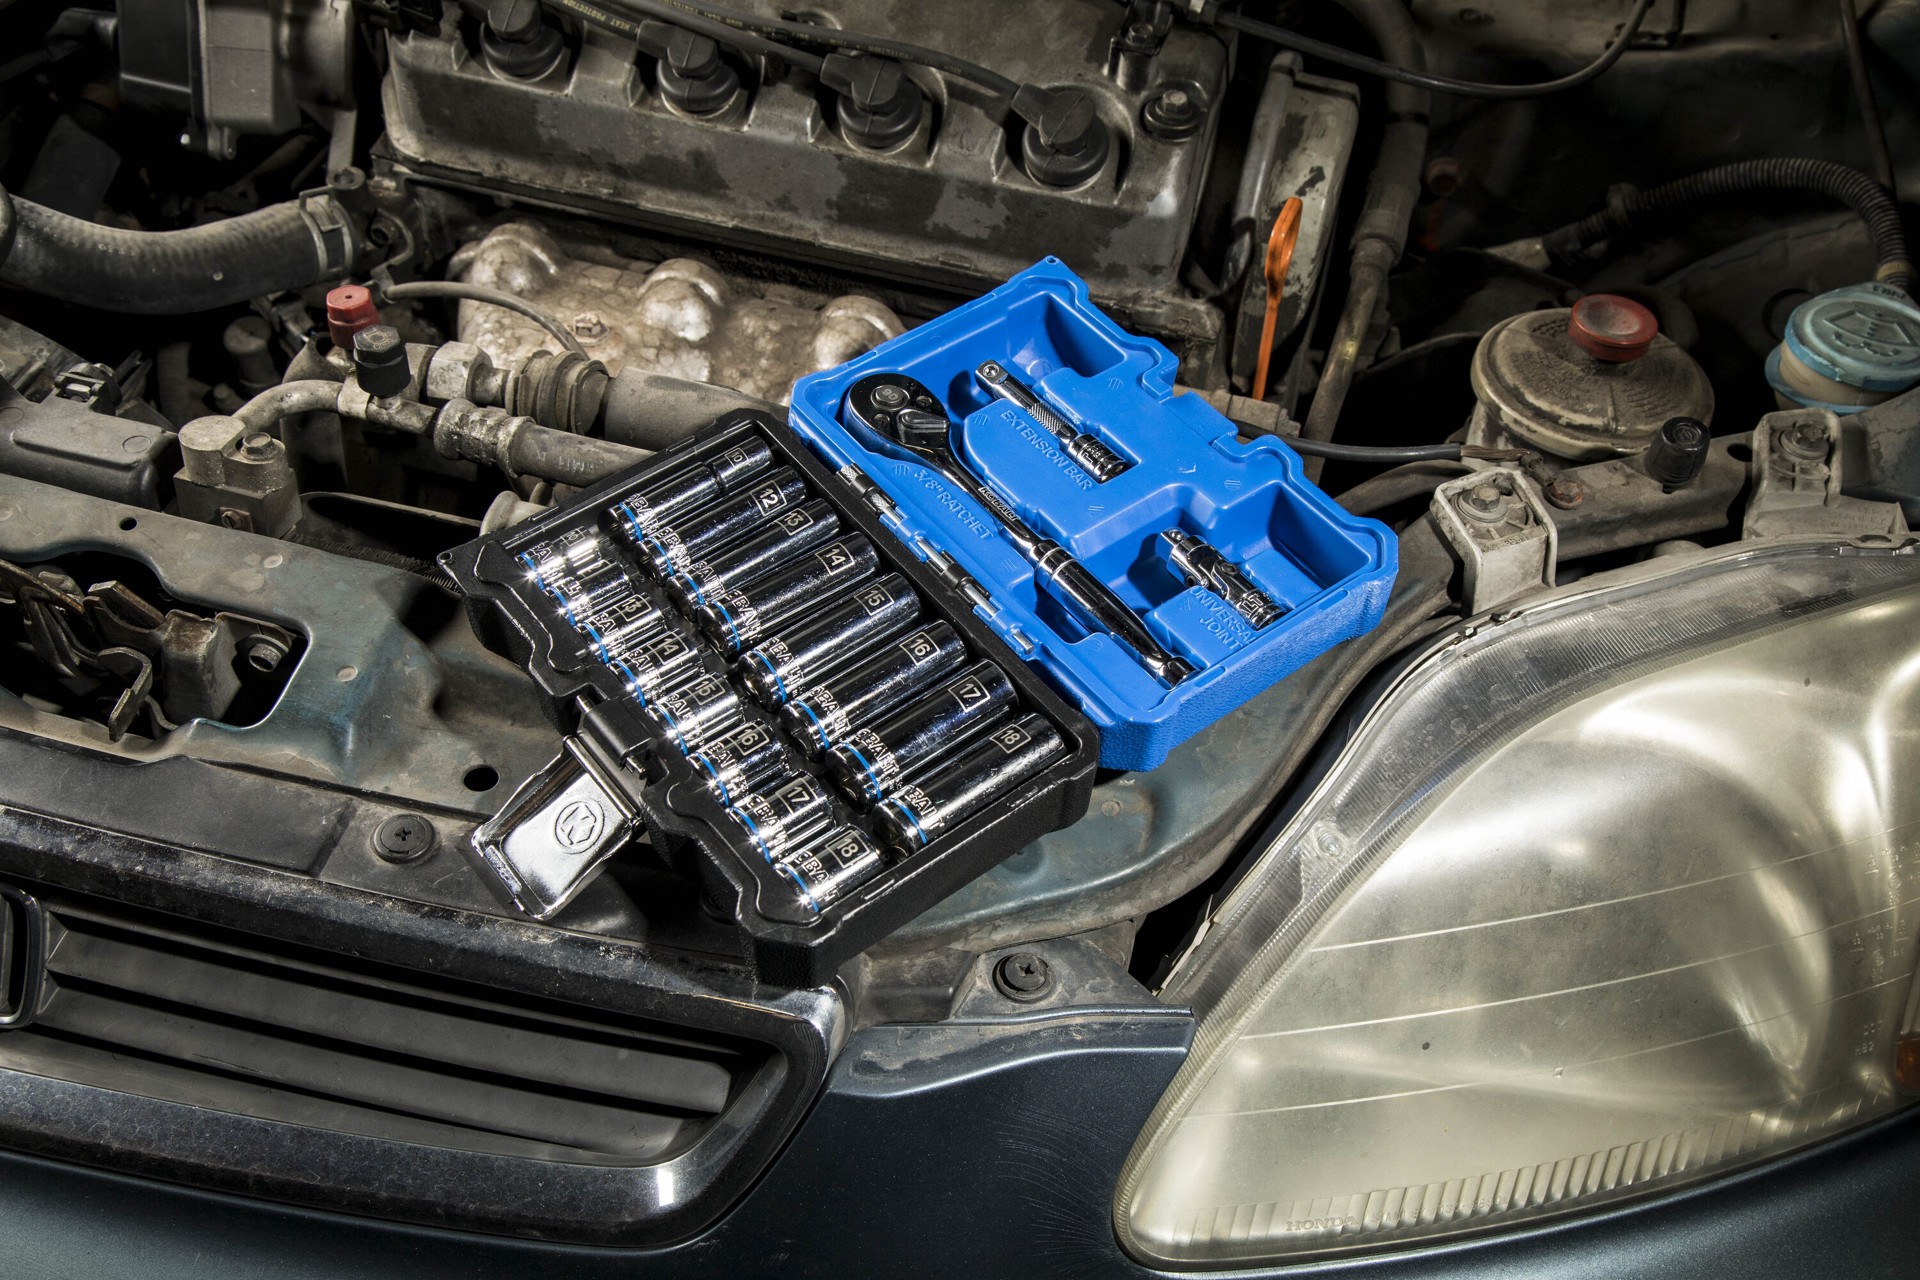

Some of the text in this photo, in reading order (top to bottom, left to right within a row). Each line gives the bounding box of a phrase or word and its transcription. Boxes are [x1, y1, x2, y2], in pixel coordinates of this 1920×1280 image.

[1000, 408, 1066, 469] EXTENSION
[1058, 460, 1094, 492] BAR
[760, 488, 779, 508] 12
[784, 512, 803, 527] 13
[936, 489, 995, 541] RATCHET
[825, 547, 847, 567] 14
[621, 598, 642, 613] 13
[864, 590, 886, 607] 15
[1200, 617, 1244, 651] JOINT
[657, 638, 680, 656] 14
[908, 637, 931, 657] 16
[694, 680, 716, 696] 15
[958, 682, 982, 700] 17
[737, 728, 759, 746] 16
[1000, 729, 1021, 745] 18
[787, 786, 811, 803] 17
[836, 838, 859, 858] 18
[1286, 1214, 1359, 1232] HONDA
